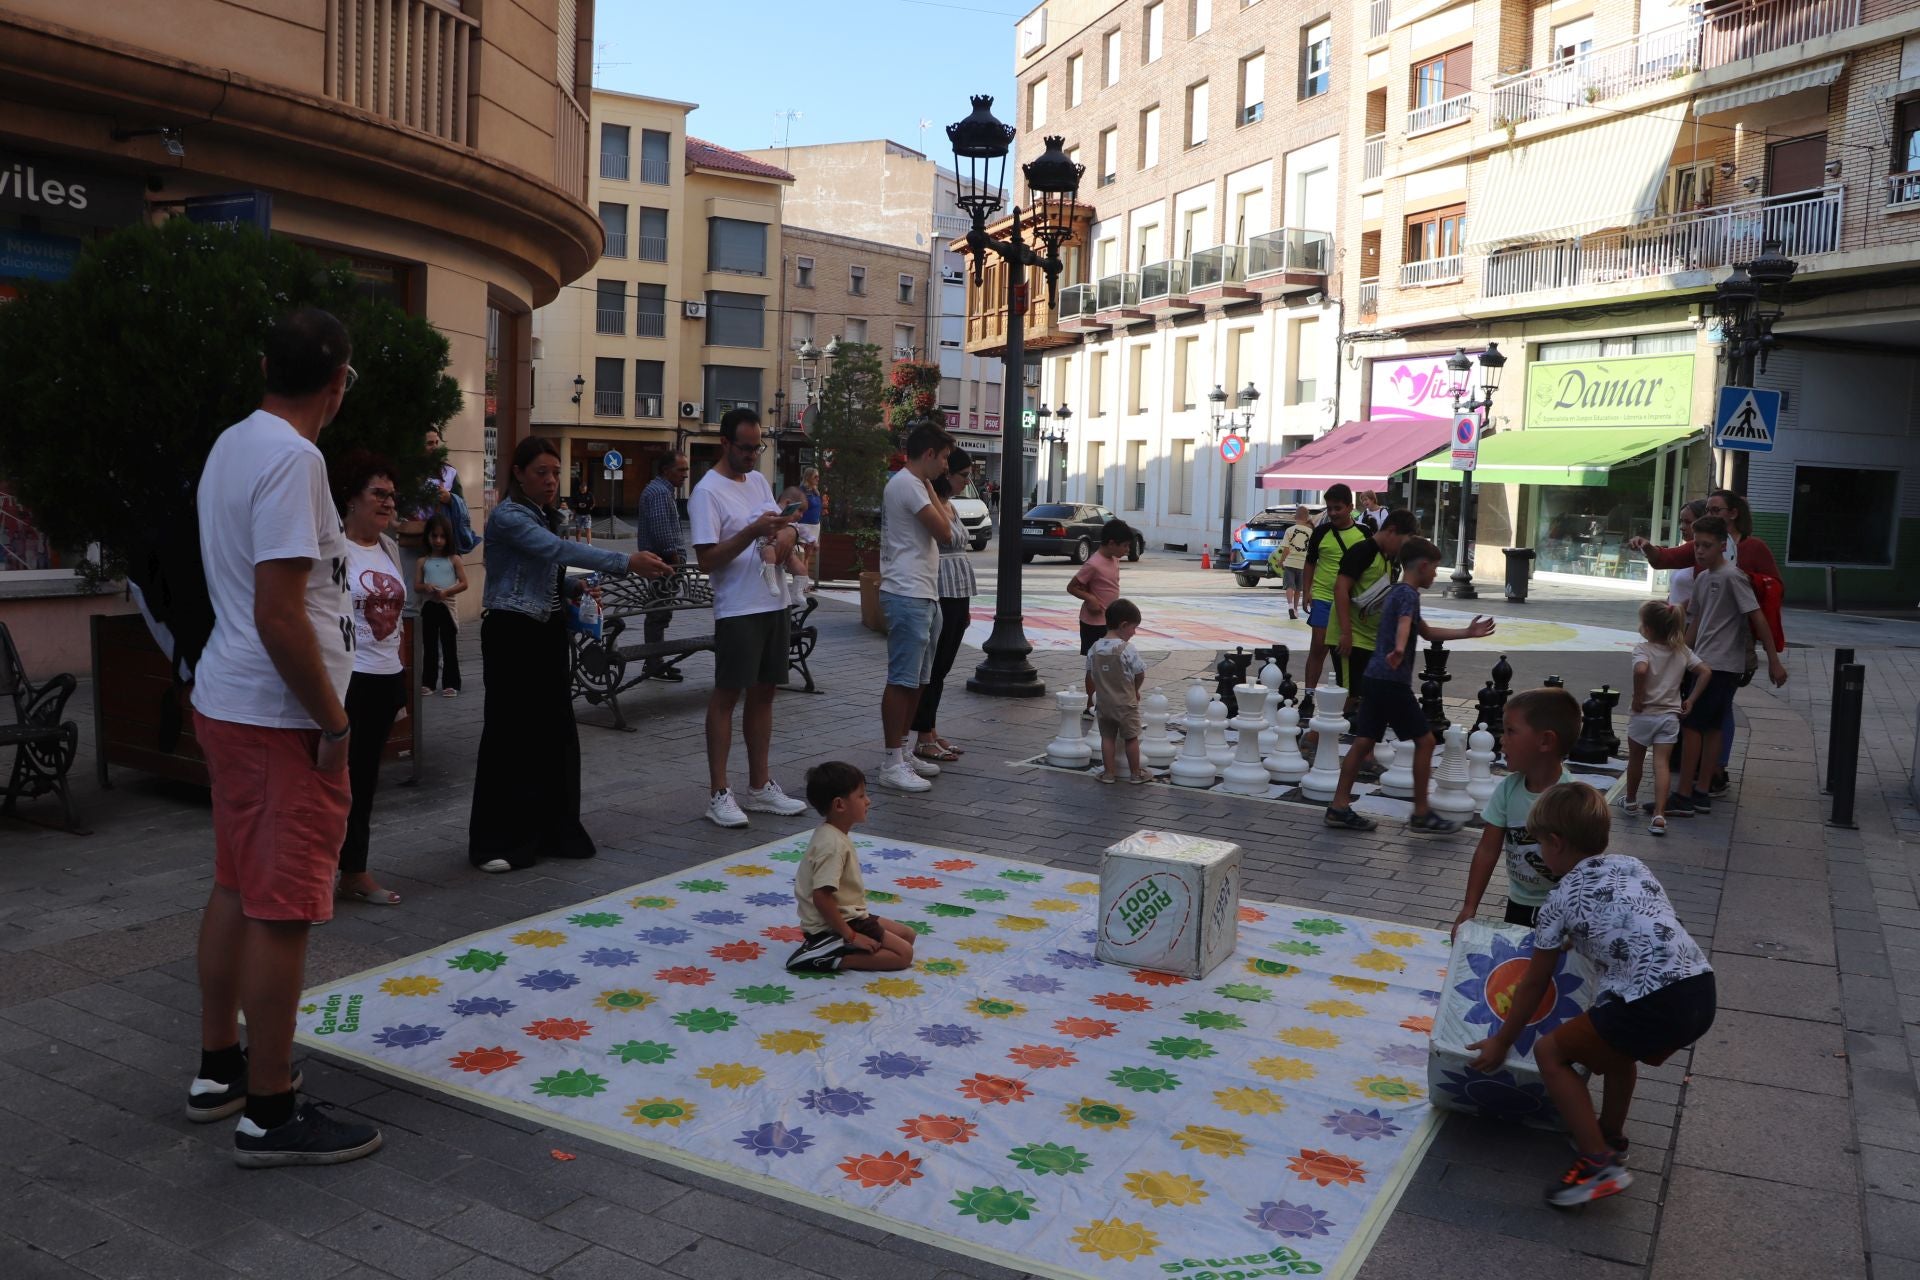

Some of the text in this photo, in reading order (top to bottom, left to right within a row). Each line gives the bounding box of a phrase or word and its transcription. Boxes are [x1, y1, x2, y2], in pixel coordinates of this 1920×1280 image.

[1553, 369, 1662, 410] Damar
[985, 419, 999, 428] PSOE
[957, 441, 986, 449] FARMACIA
[1118, 879, 1159, 922] FOOT
[1127, 890, 1173, 937] RIGHT
[314, 994, 343, 1035] Garden
[338, 994, 364, 1033] Games
[1160, 1246, 1302, 1273] Games
[1167, 1261, 1323, 1280] Garde
